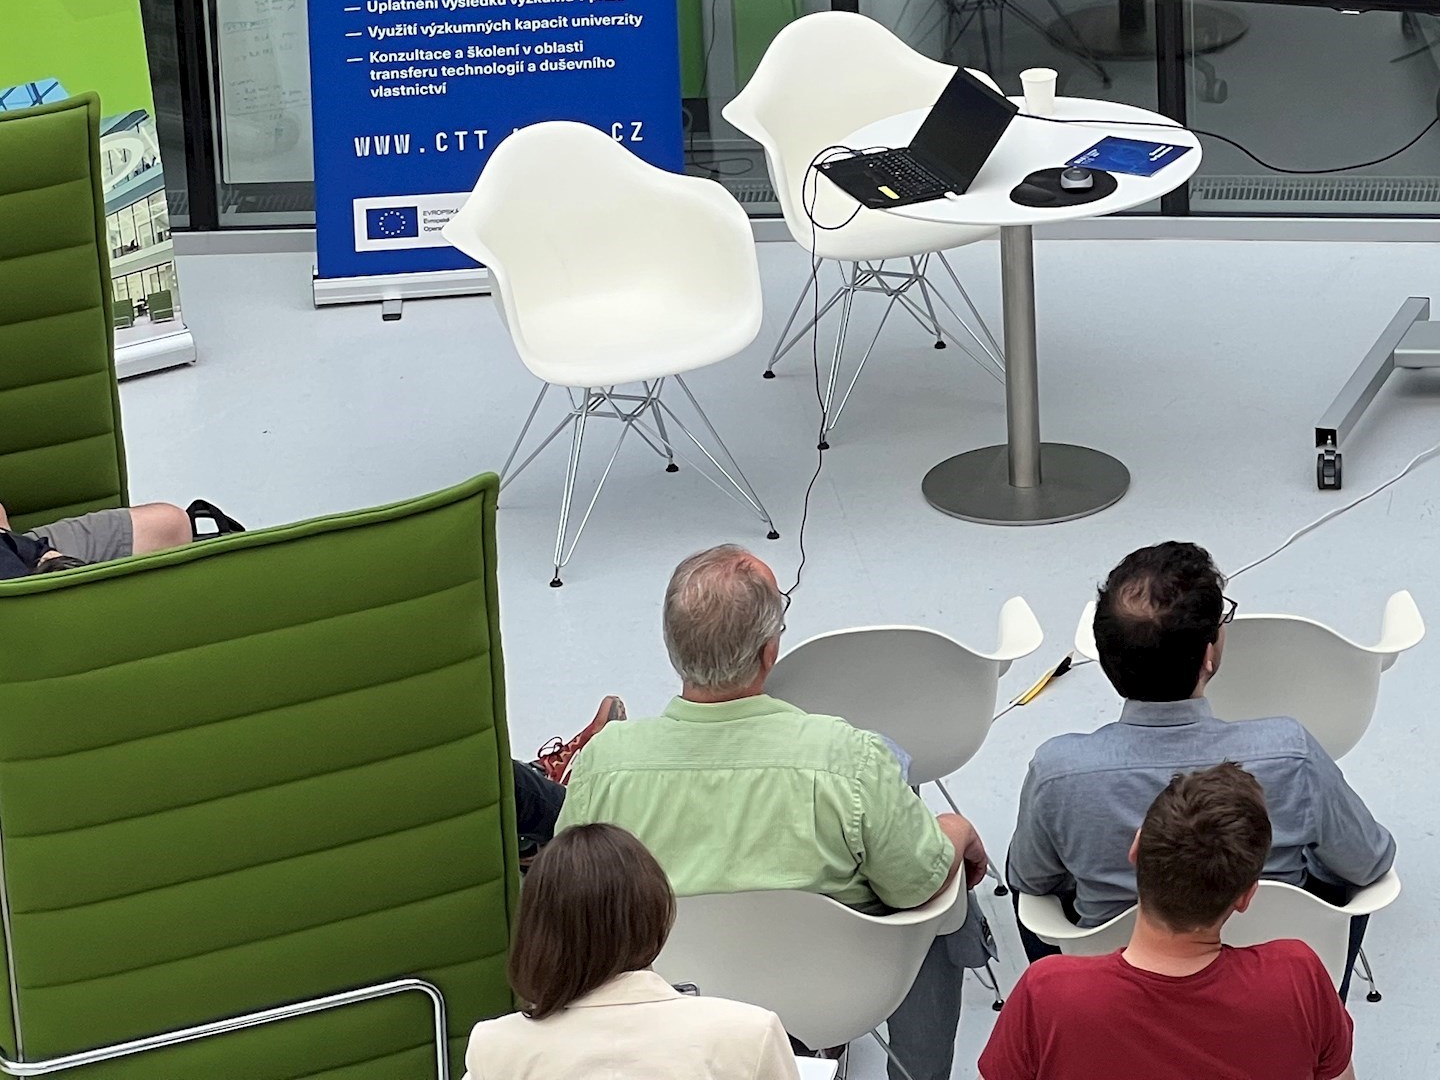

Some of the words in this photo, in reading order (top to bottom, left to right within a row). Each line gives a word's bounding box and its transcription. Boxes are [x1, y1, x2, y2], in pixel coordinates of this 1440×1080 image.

[367, 22, 417, 40] Využití
[419, 18, 511, 37] výzkumných
[514, 15, 568, 31] kapacit
[571, 12, 642, 27] univerzity
[369, 48, 451, 63] Konzultace
[454, 49, 463, 58] a
[466, 43, 519, 58] školení
[521, 45, 531, 54] v
[534, 39, 583, 54] oblasti
[369, 65, 437, 80] transferu
[440, 60, 524, 76] technologií
[527, 62, 536, 72] a
[539, 56, 615, 71] duševního
[370, 81, 446, 97] vlastnictví
